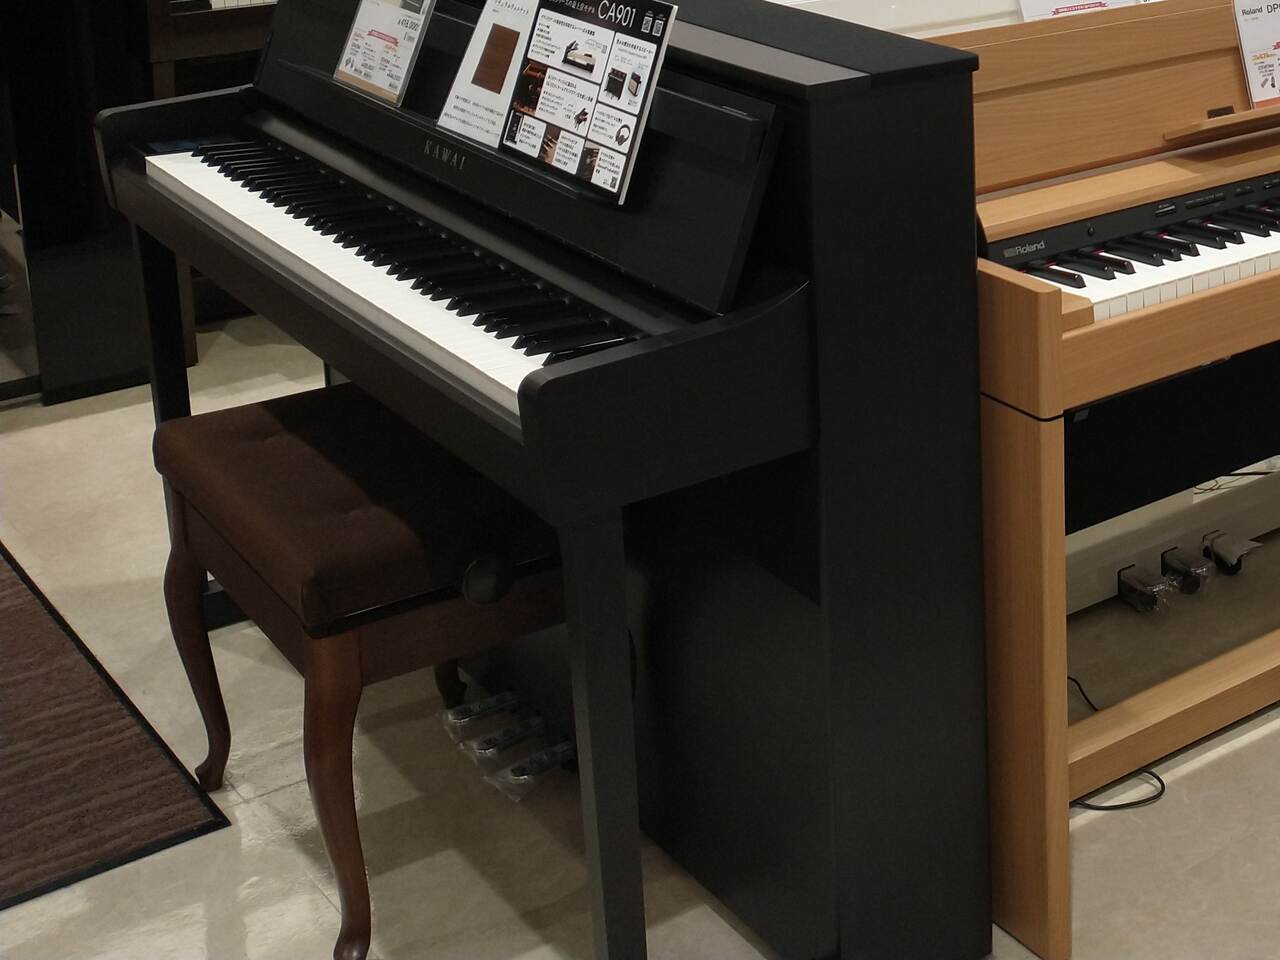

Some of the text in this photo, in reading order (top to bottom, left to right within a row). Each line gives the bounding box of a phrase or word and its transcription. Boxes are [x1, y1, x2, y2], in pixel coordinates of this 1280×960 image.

[598, 0, 636, 28] CA901
[1241, 6, 1263, 16] Roland
[424, 140, 466, 170] KAWAI
[1015, 240, 1045, 256] Roland
